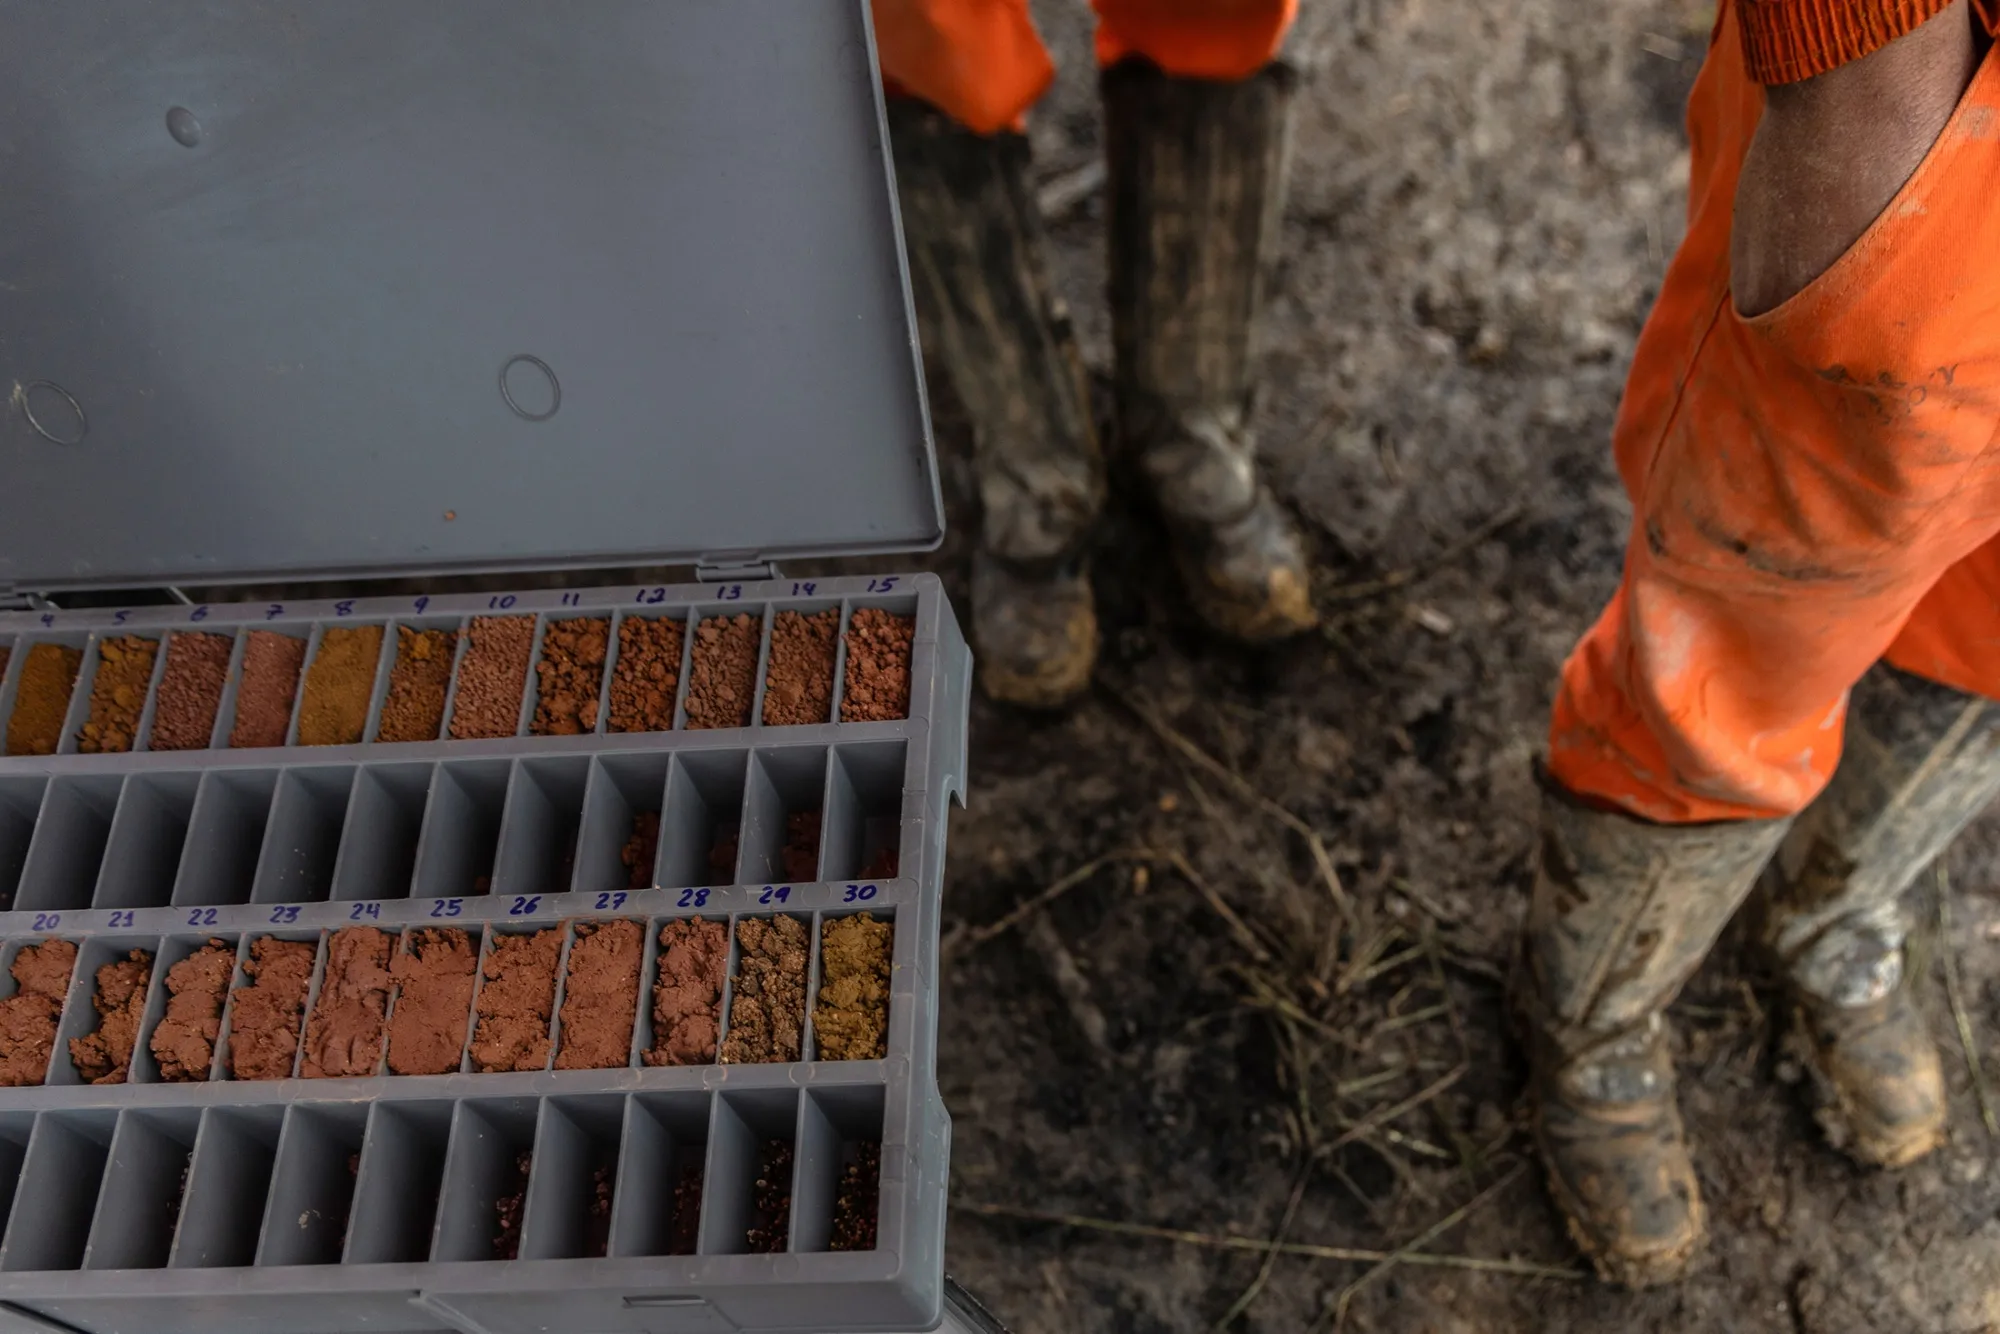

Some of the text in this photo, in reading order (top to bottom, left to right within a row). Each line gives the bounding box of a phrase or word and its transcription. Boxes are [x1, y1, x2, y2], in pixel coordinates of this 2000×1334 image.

[40, 576, 900, 628] 4 5 6 7 8 9 10 11 12 13 14 15
[32, 884, 878, 931] 20 21 22 23 24 25 26 27 28 29 30
